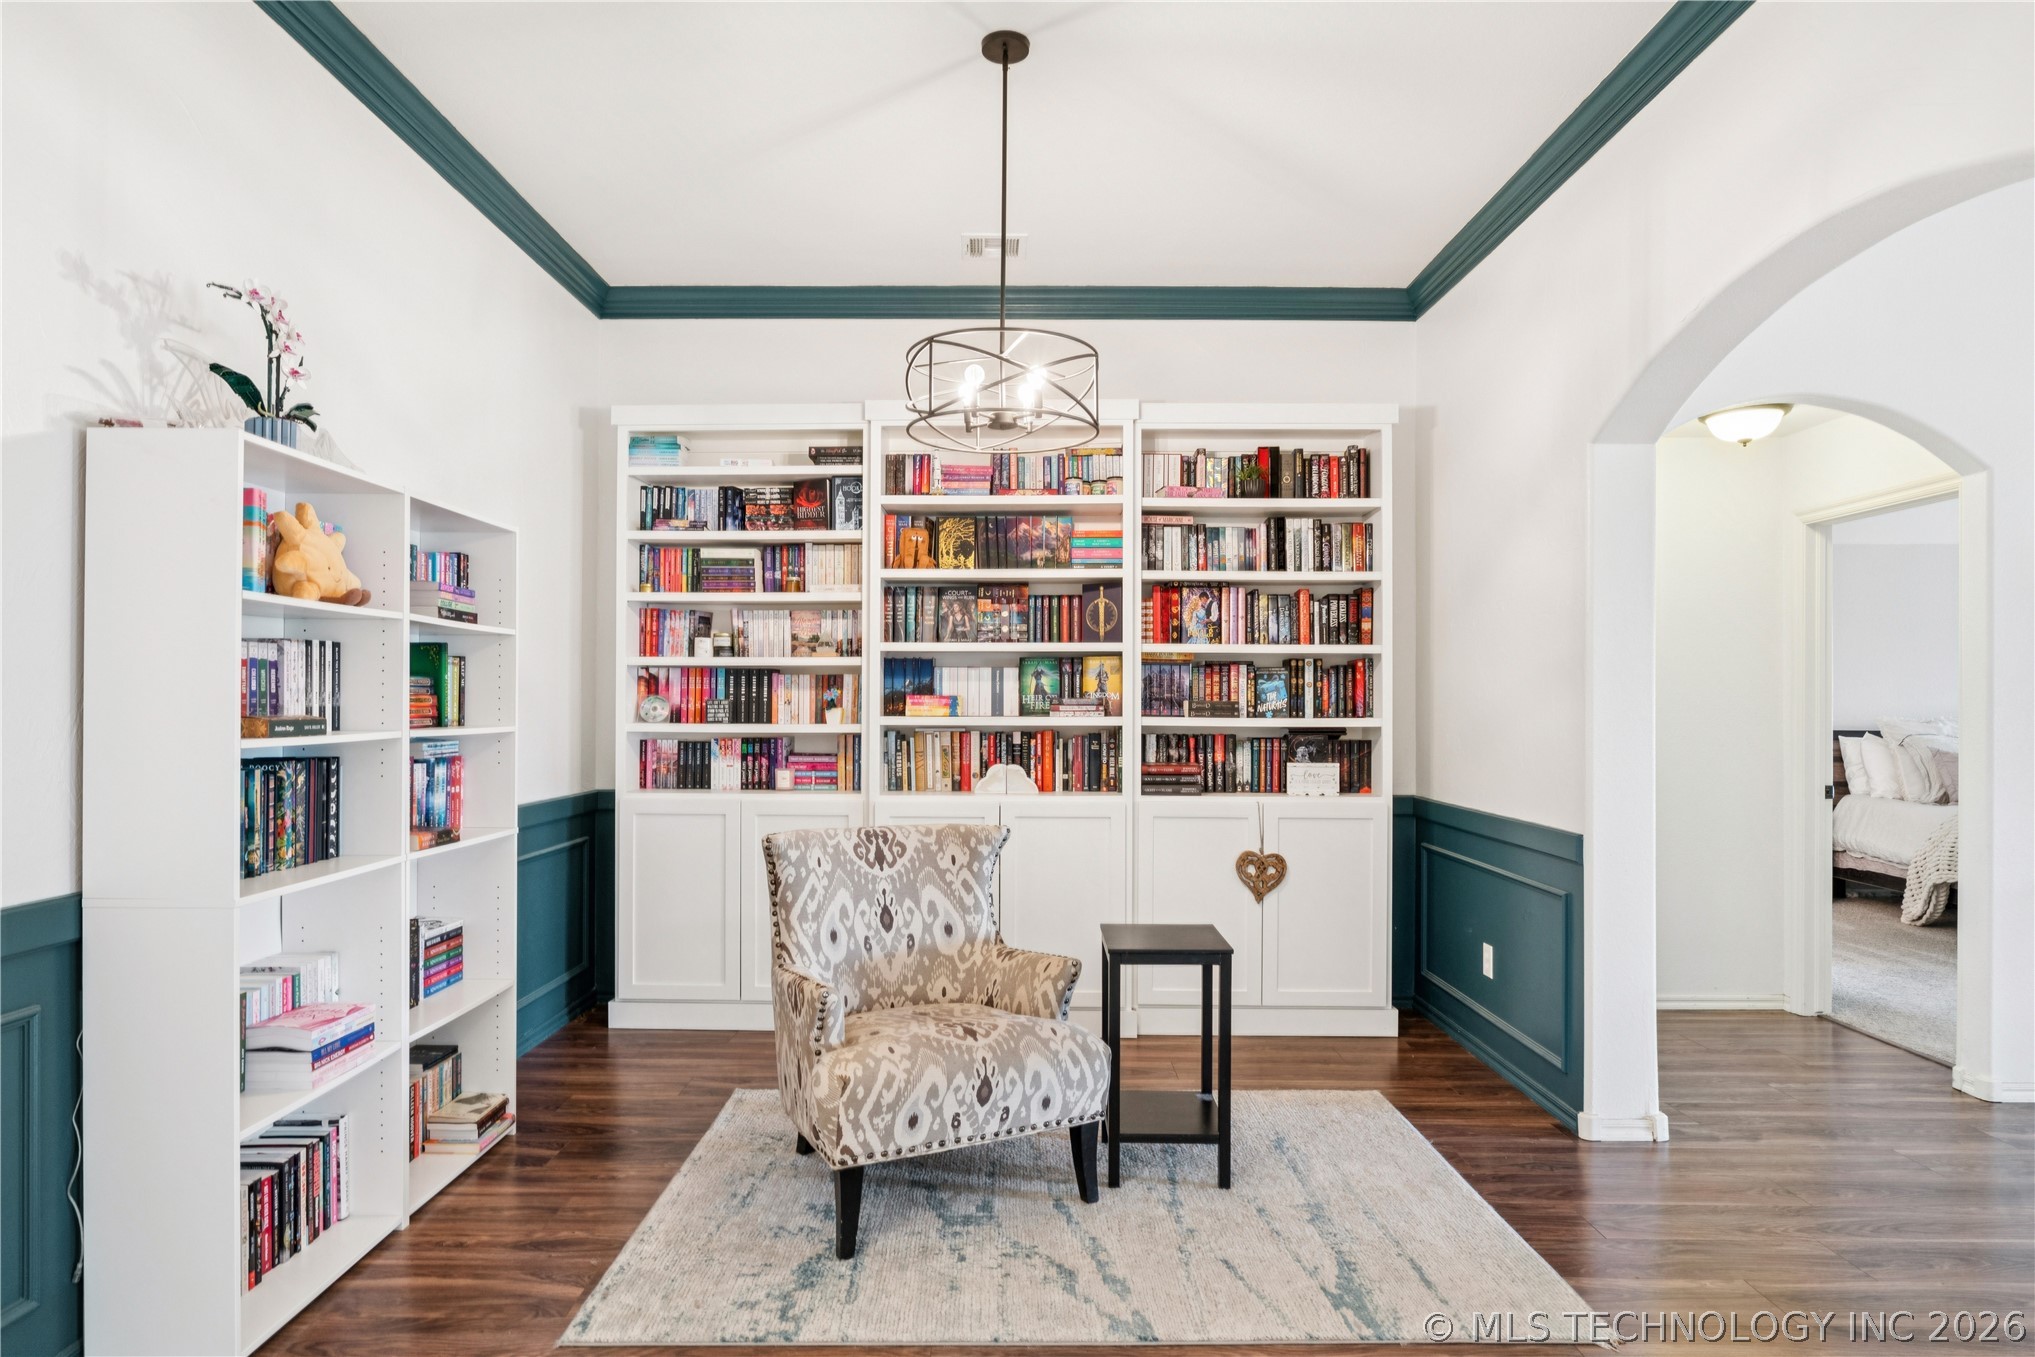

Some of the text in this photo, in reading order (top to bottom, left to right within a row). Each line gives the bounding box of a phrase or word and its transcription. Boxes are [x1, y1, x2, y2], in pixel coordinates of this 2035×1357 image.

[1022, 694, 1044, 704] HEIR
[1266, 691, 1277, 701] THE
[1030, 702, 1050, 710] FIRE
[1257, 698, 1287, 712] NATURALS
